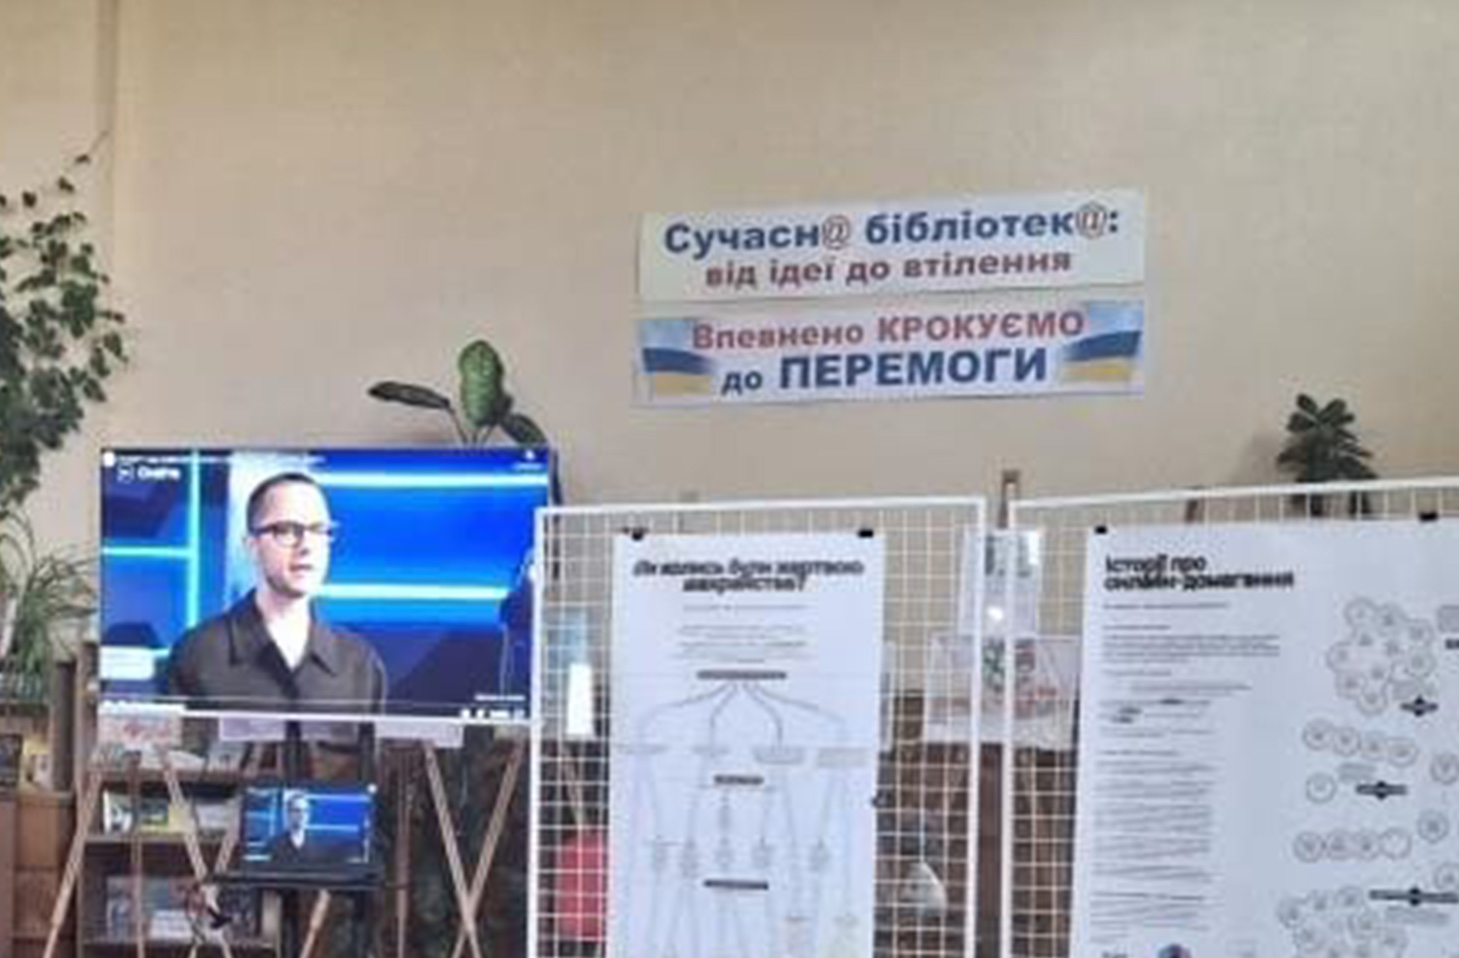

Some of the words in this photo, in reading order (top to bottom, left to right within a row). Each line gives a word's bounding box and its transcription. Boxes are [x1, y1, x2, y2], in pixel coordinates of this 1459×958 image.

[665, 215, 851, 260] Сучасн@
[865, 201, 1119, 245] бібліотек@:
[706, 261, 756, 290] від
[769, 257, 835, 289] ідеї
[845, 259, 891, 286] до
[903, 250, 1072, 280] втілення
[693, 323, 865, 350] Впевнено
[878, 310, 1085, 343] КРОКУЄМО
[722, 370, 763, 396] до
[781, 348, 1047, 390] ПЕРЕМОГИ
